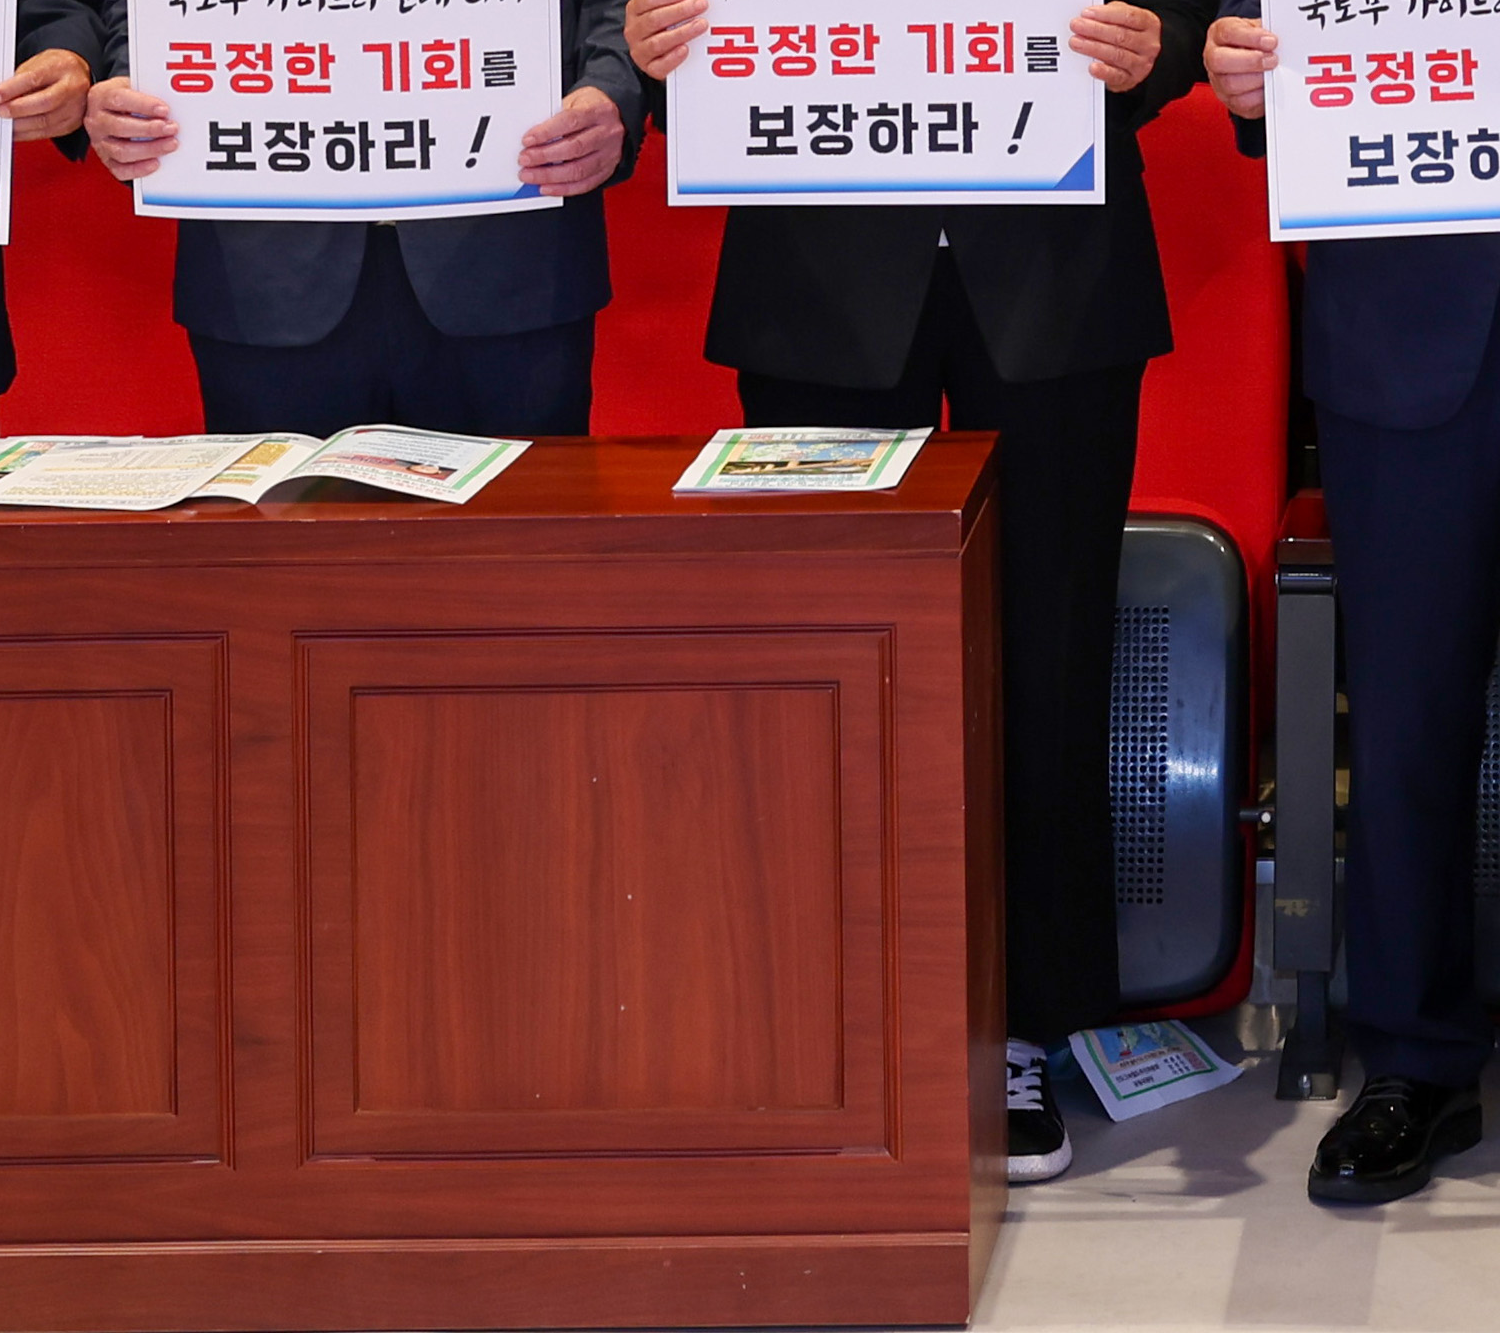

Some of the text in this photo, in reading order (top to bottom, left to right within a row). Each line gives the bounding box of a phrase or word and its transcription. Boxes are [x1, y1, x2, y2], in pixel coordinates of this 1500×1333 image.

[166, 39, 517, 93] 공정한 기회를
[707, 22, 1060, 77] 공정한 기회를
[1305, 49, 1478, 107] 공정한
[206, 119, 436, 172] 보장하라
[746, 102, 978, 156] 보장하라
